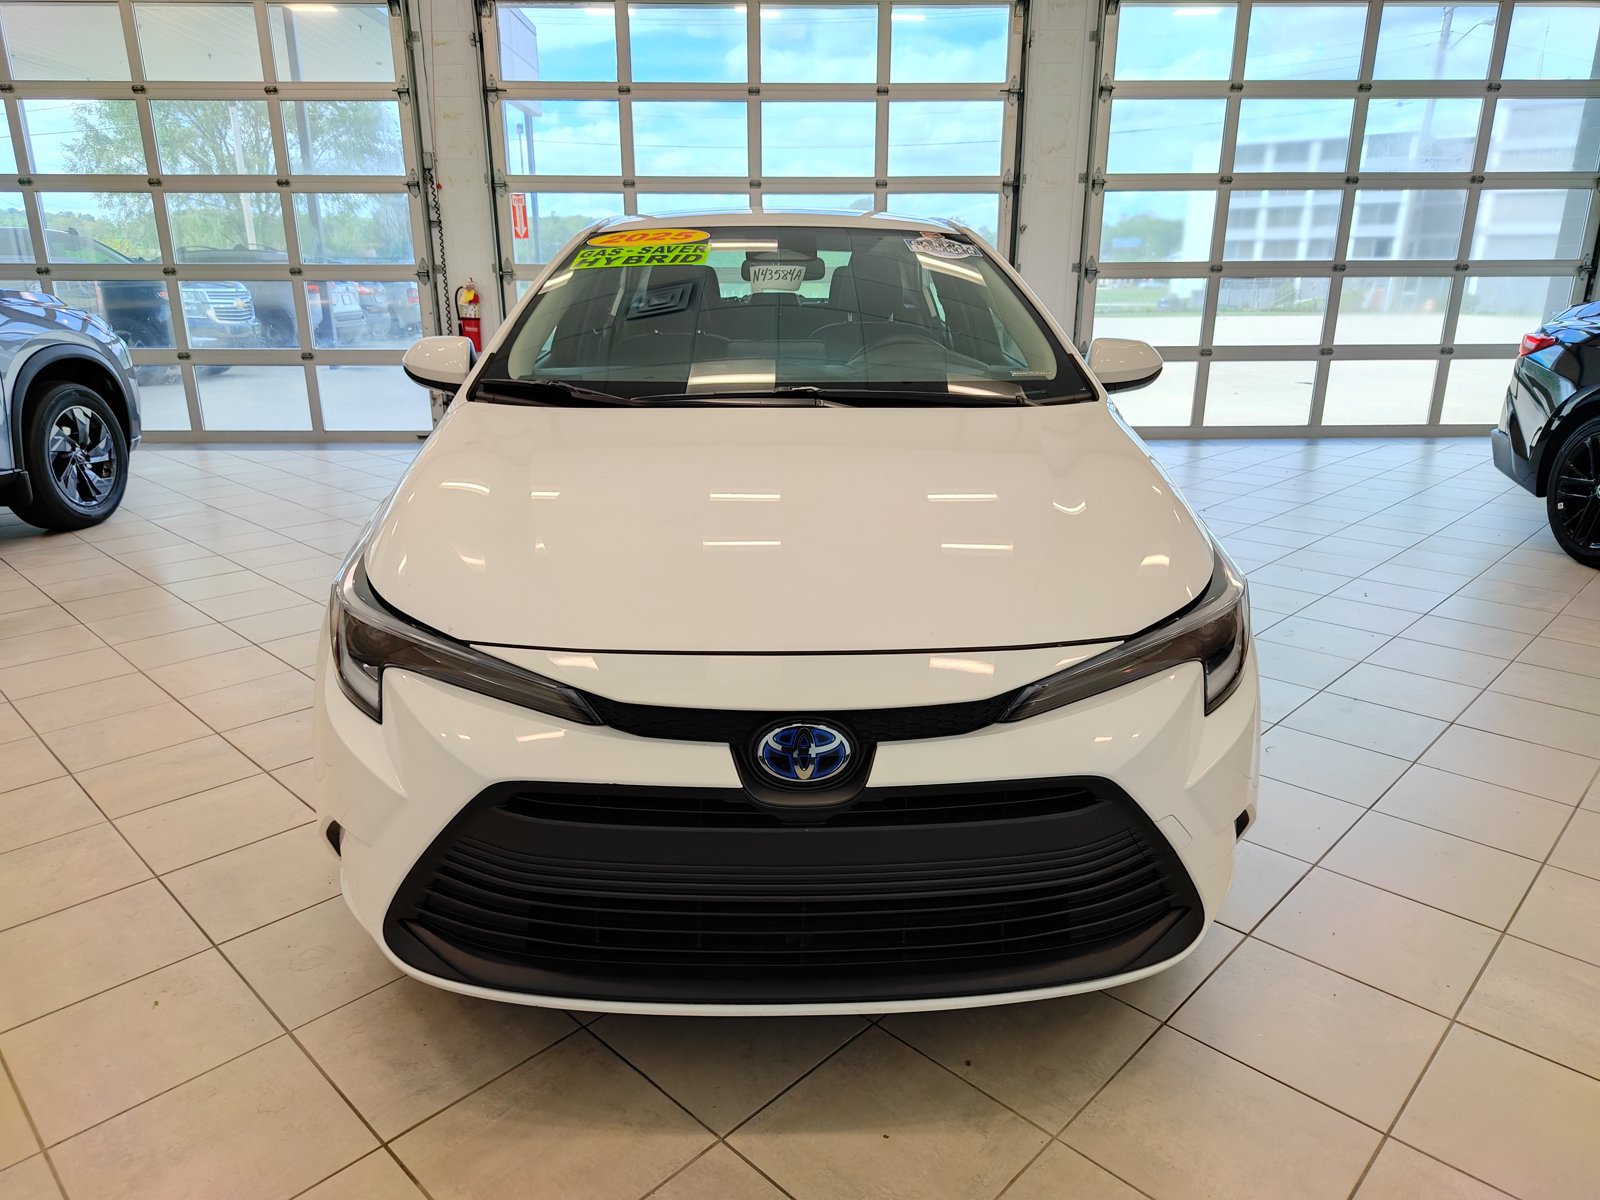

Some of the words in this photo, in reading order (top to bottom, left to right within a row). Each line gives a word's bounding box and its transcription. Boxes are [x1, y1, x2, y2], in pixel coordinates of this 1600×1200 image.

[602, 231, 697, 244] 2025
[577, 254, 703, 267] HYBRID
[752, 267, 802, 283] N43584A
